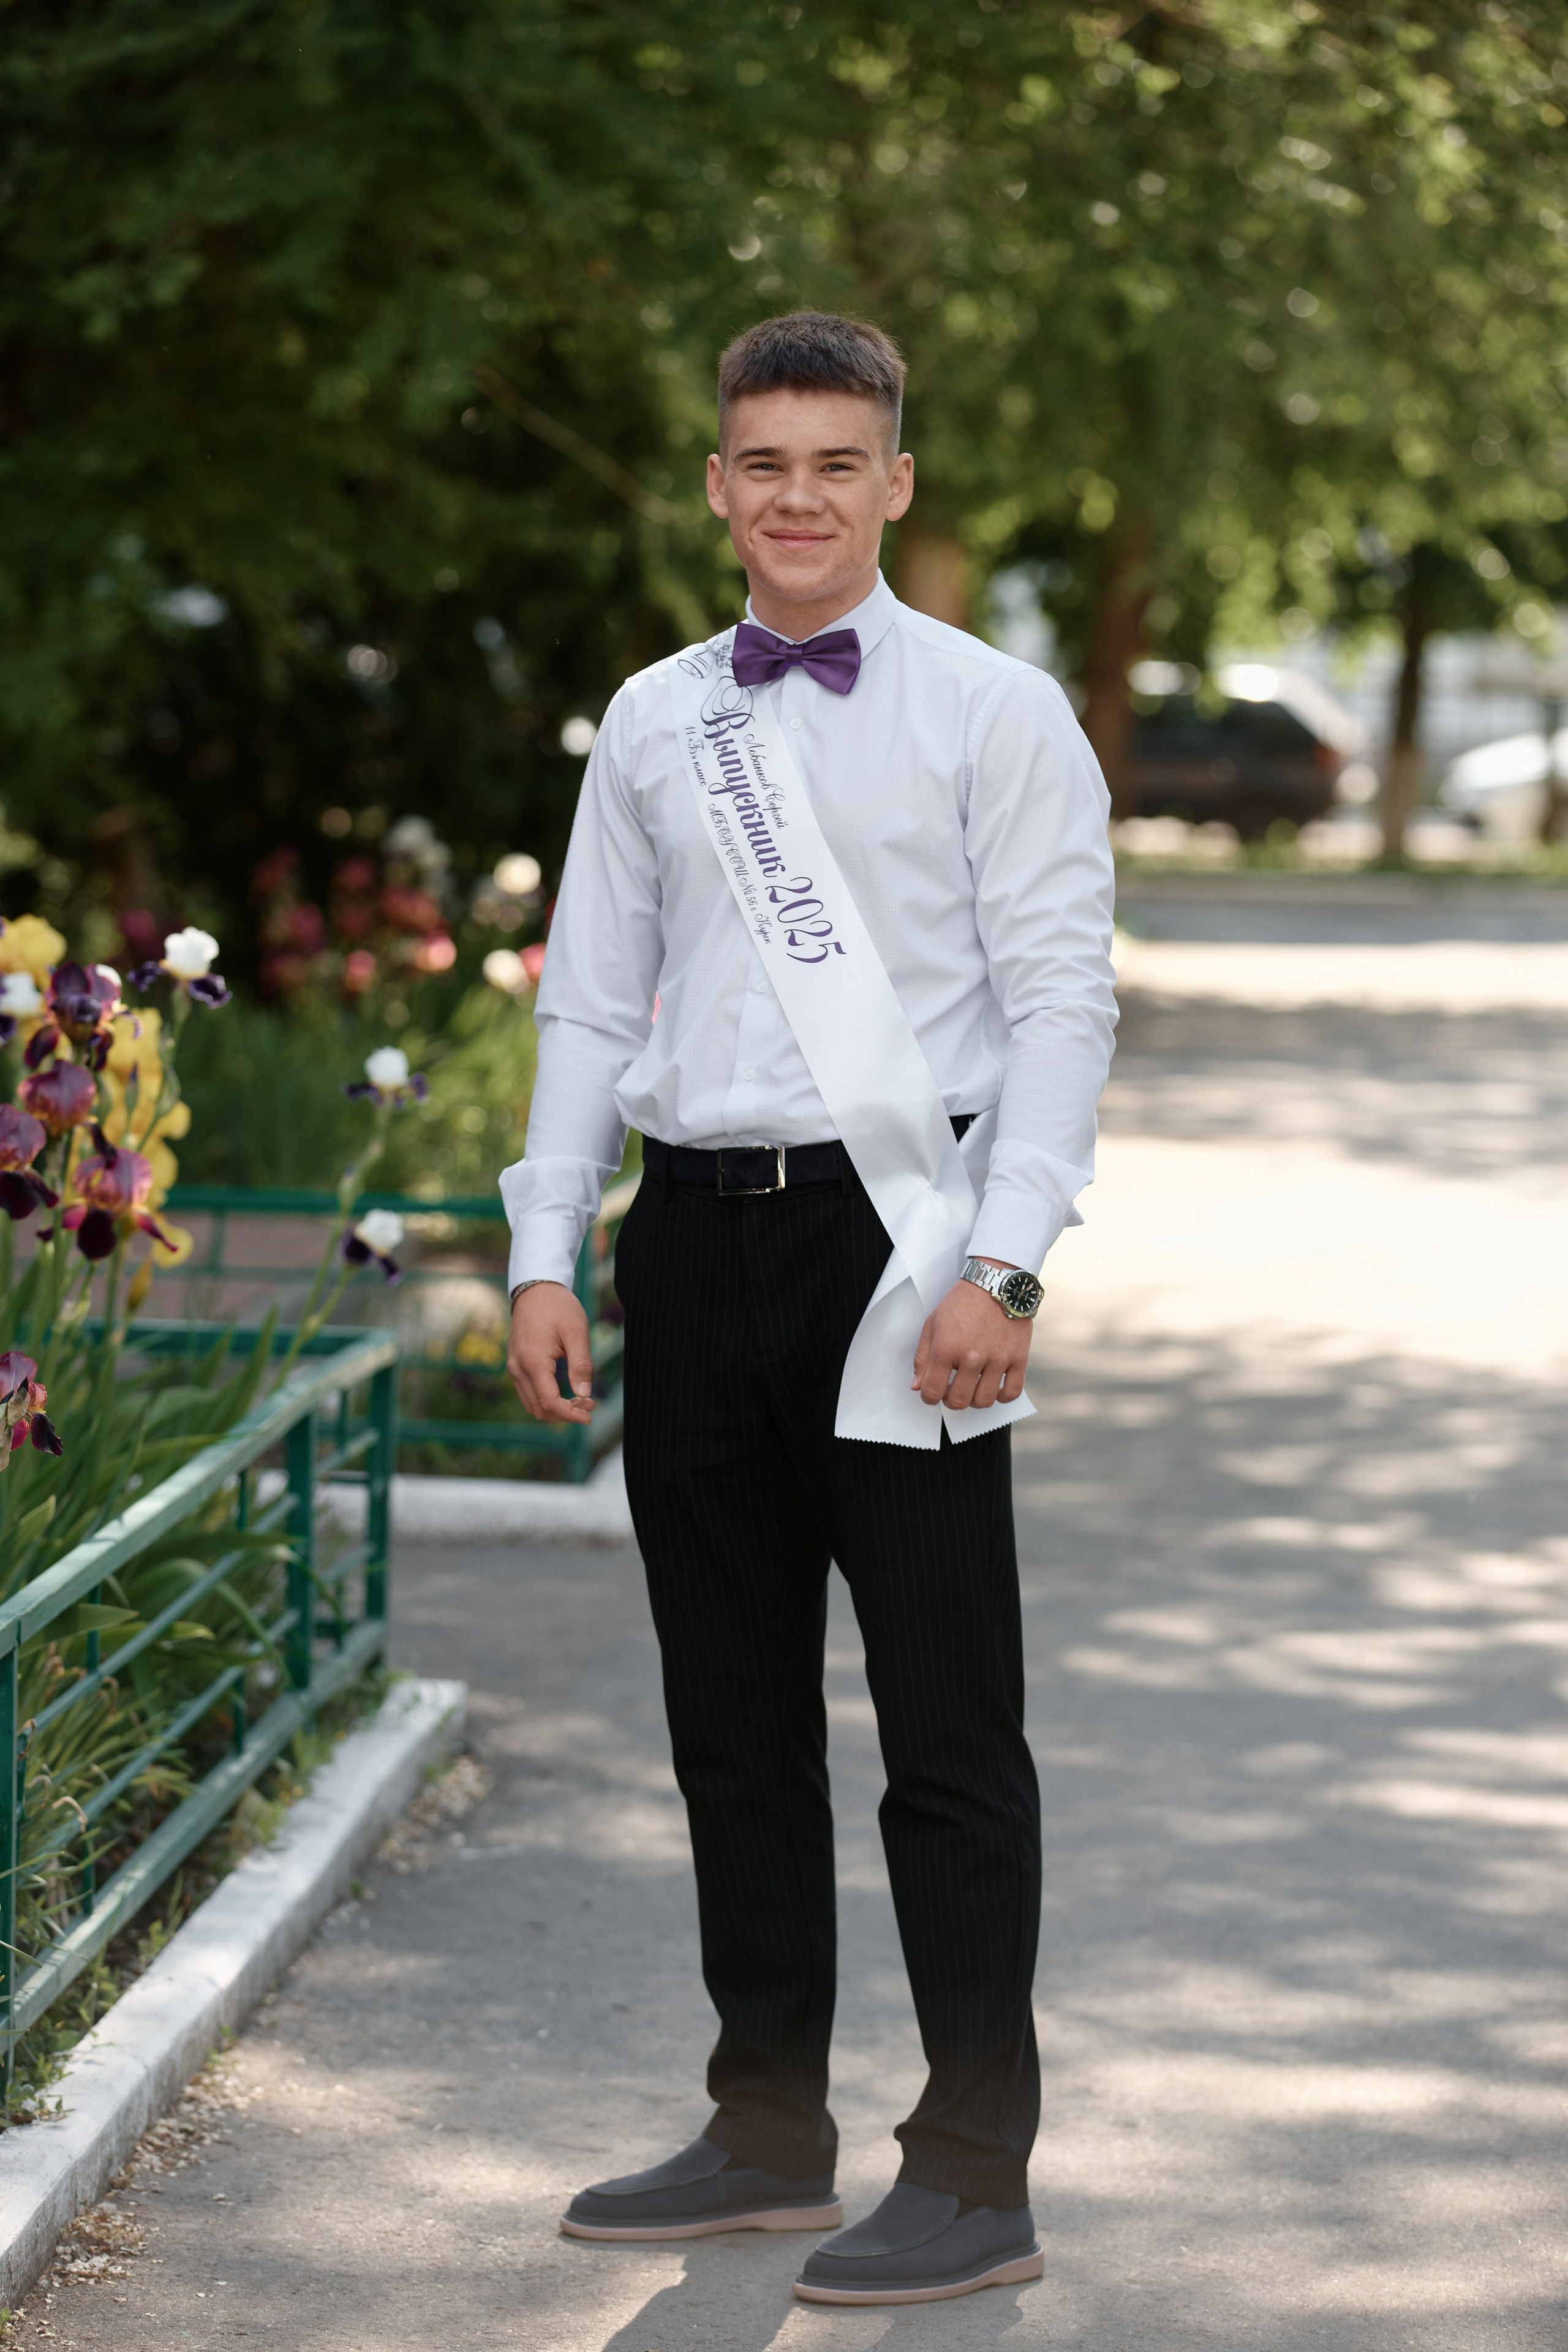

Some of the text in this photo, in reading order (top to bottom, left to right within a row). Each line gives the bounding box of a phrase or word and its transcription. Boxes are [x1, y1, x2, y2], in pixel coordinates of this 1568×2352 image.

[685, 726, 696, 734] 11
[693, 761, 706, 786] класс
[755, 913, 772, 944] Курск
[701, 676, 846, 963] Выпускник 2025
[744, 734, 788, 829] Лобанков Сергей
